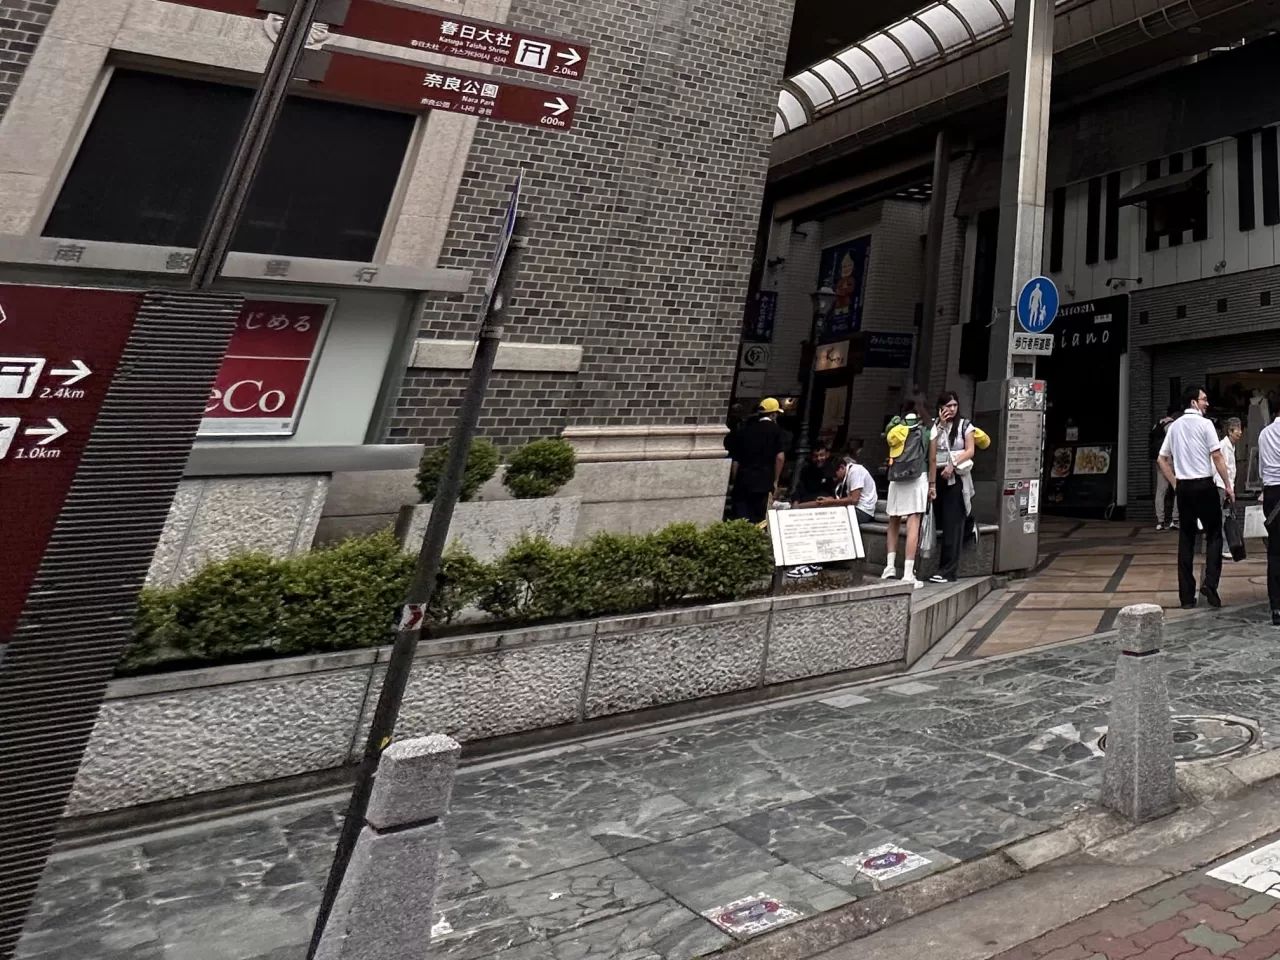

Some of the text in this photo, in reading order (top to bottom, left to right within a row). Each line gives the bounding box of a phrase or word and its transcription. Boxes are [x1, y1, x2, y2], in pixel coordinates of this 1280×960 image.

[440, 20, 513, 48] 春日大社
[438, 36, 510, 56] Kasuga Taisha Shrine
[553, 65, 578, 77] 2.0km
[422, 72, 499, 99] 奈良公園
[460, 104, 475, 113] 나라
[461, 96, 495, 107] Nara Park
[540, 115, 565, 127] 600m
[236, 312, 311, 332] じめる
[1057, 329, 1110, 349] iano
[39, 387, 85, 400] 2.4km
[204, 379, 286, 414] eCo
[15, 447, 61, 459] 1.0km
